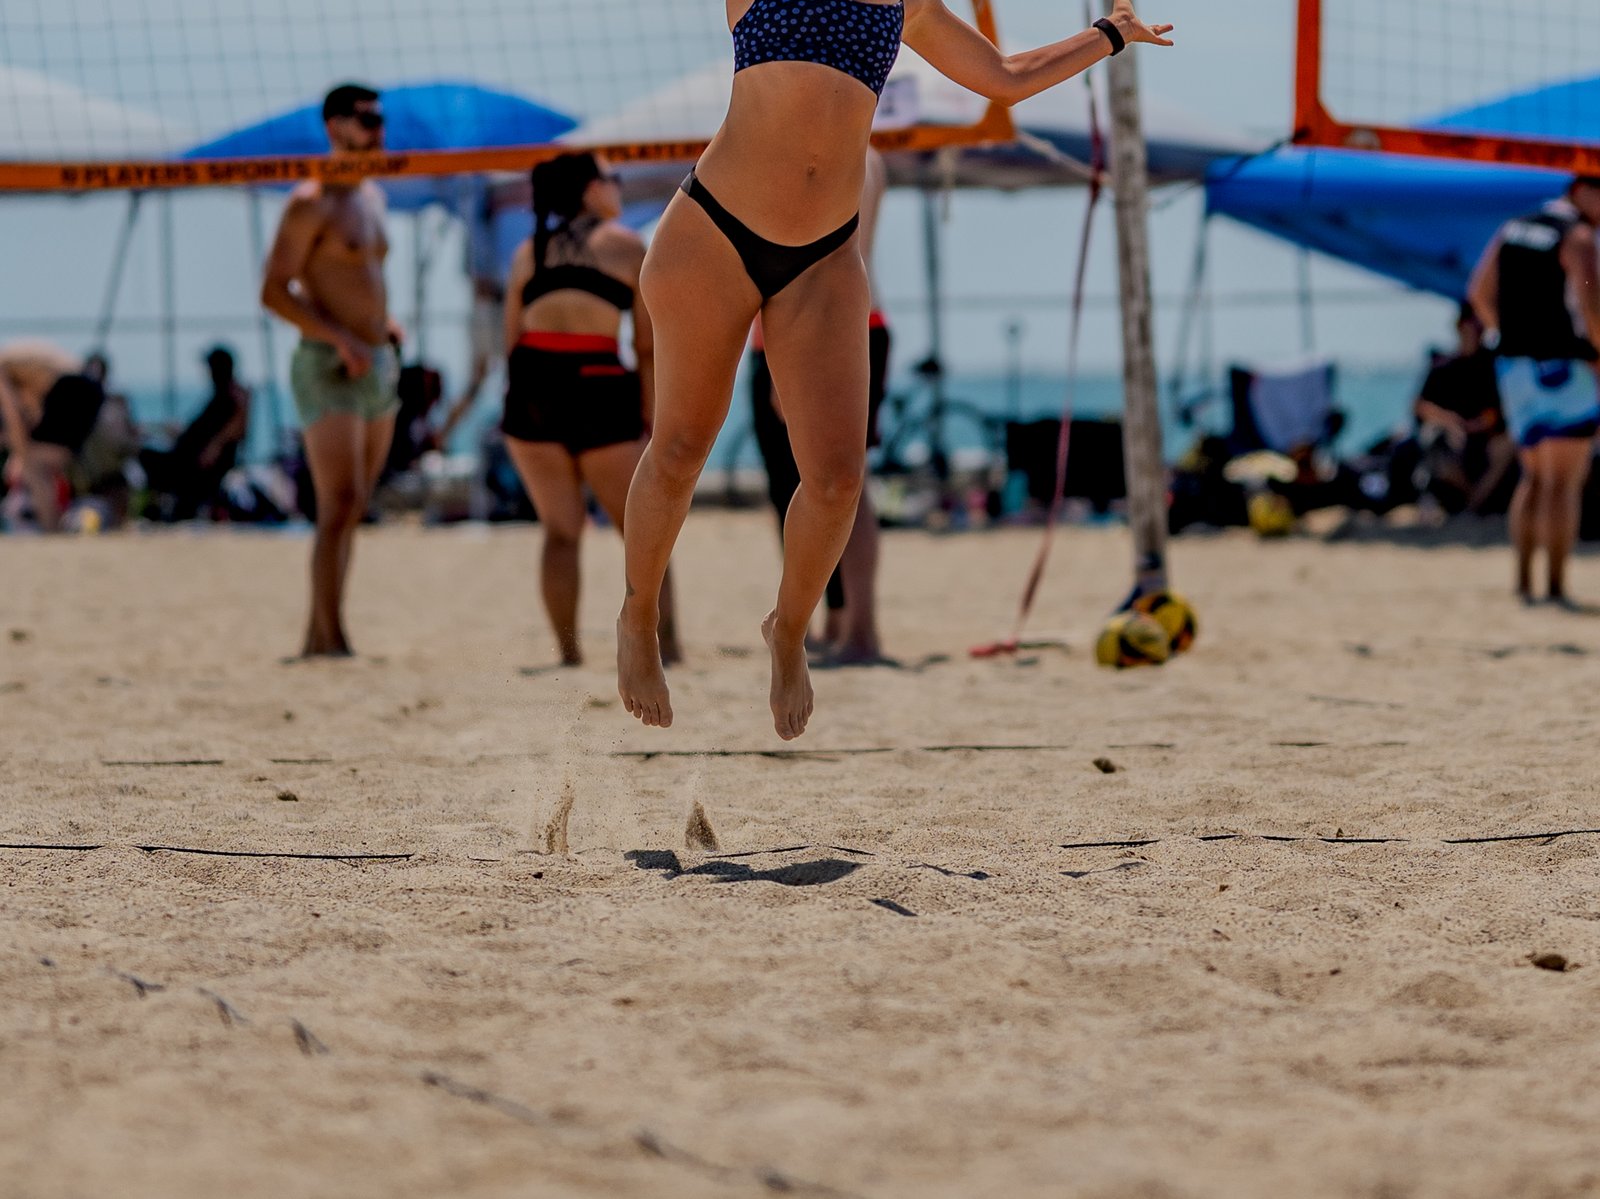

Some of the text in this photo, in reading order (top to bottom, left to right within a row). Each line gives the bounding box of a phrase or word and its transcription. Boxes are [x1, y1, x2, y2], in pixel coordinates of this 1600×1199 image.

[84, 152, 410, 186] PLAYERS SPORTS GROUP
